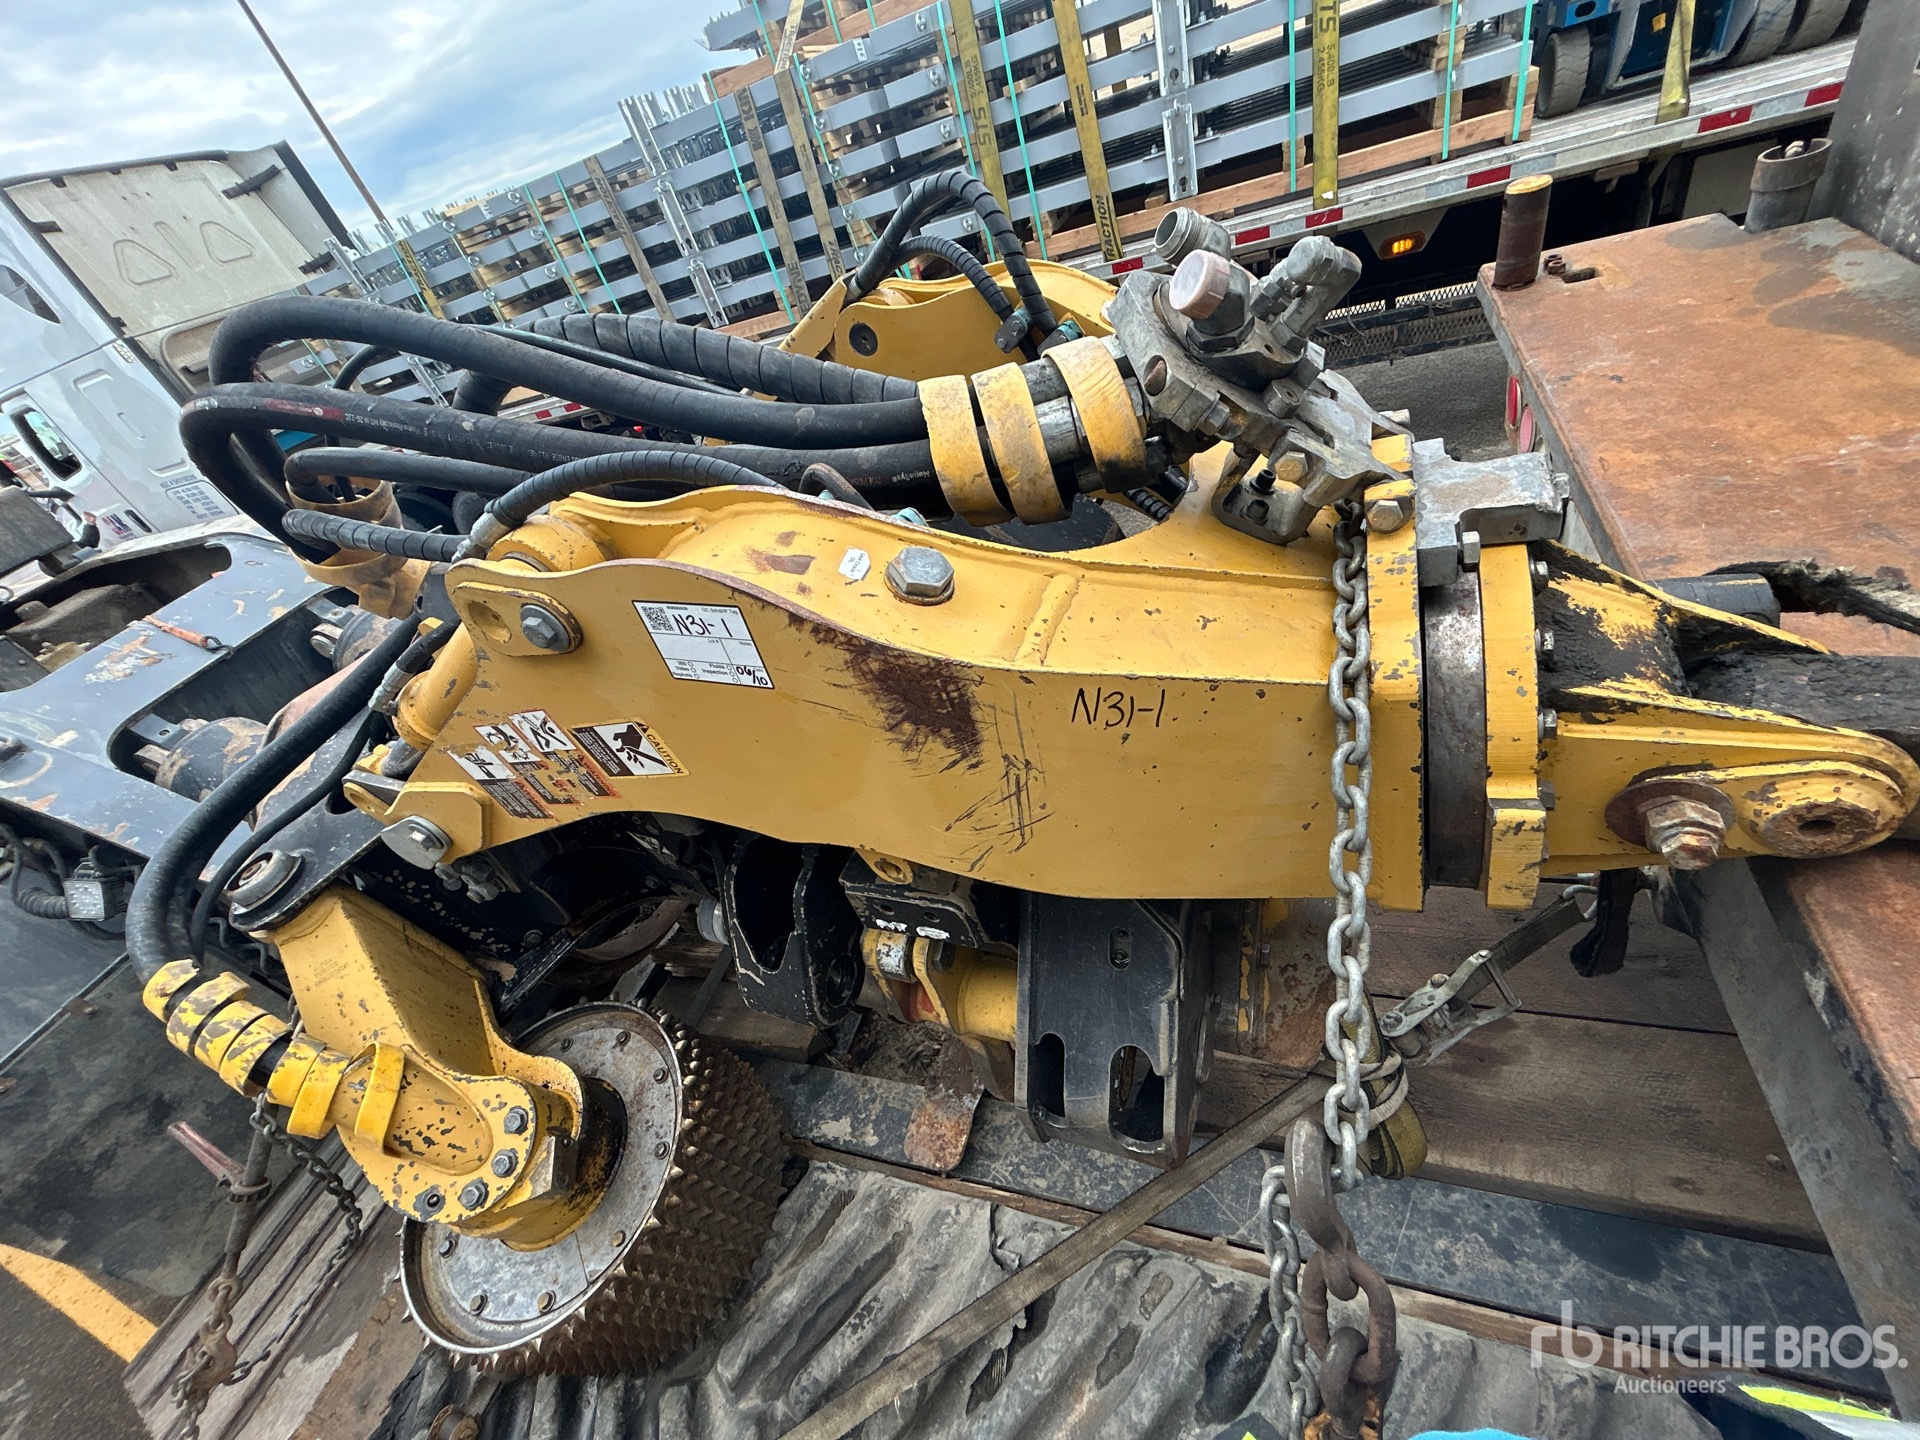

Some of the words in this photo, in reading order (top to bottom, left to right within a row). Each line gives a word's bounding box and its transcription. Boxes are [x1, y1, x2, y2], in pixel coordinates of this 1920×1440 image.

[973, 106, 992, 146] STS
[786, 260, 811, 317] EDYNE
[1071, 687, 1166, 728] N31-1
[646, 733, 684, 774] CAUTION
[584, 765, 617, 797] WARNING
